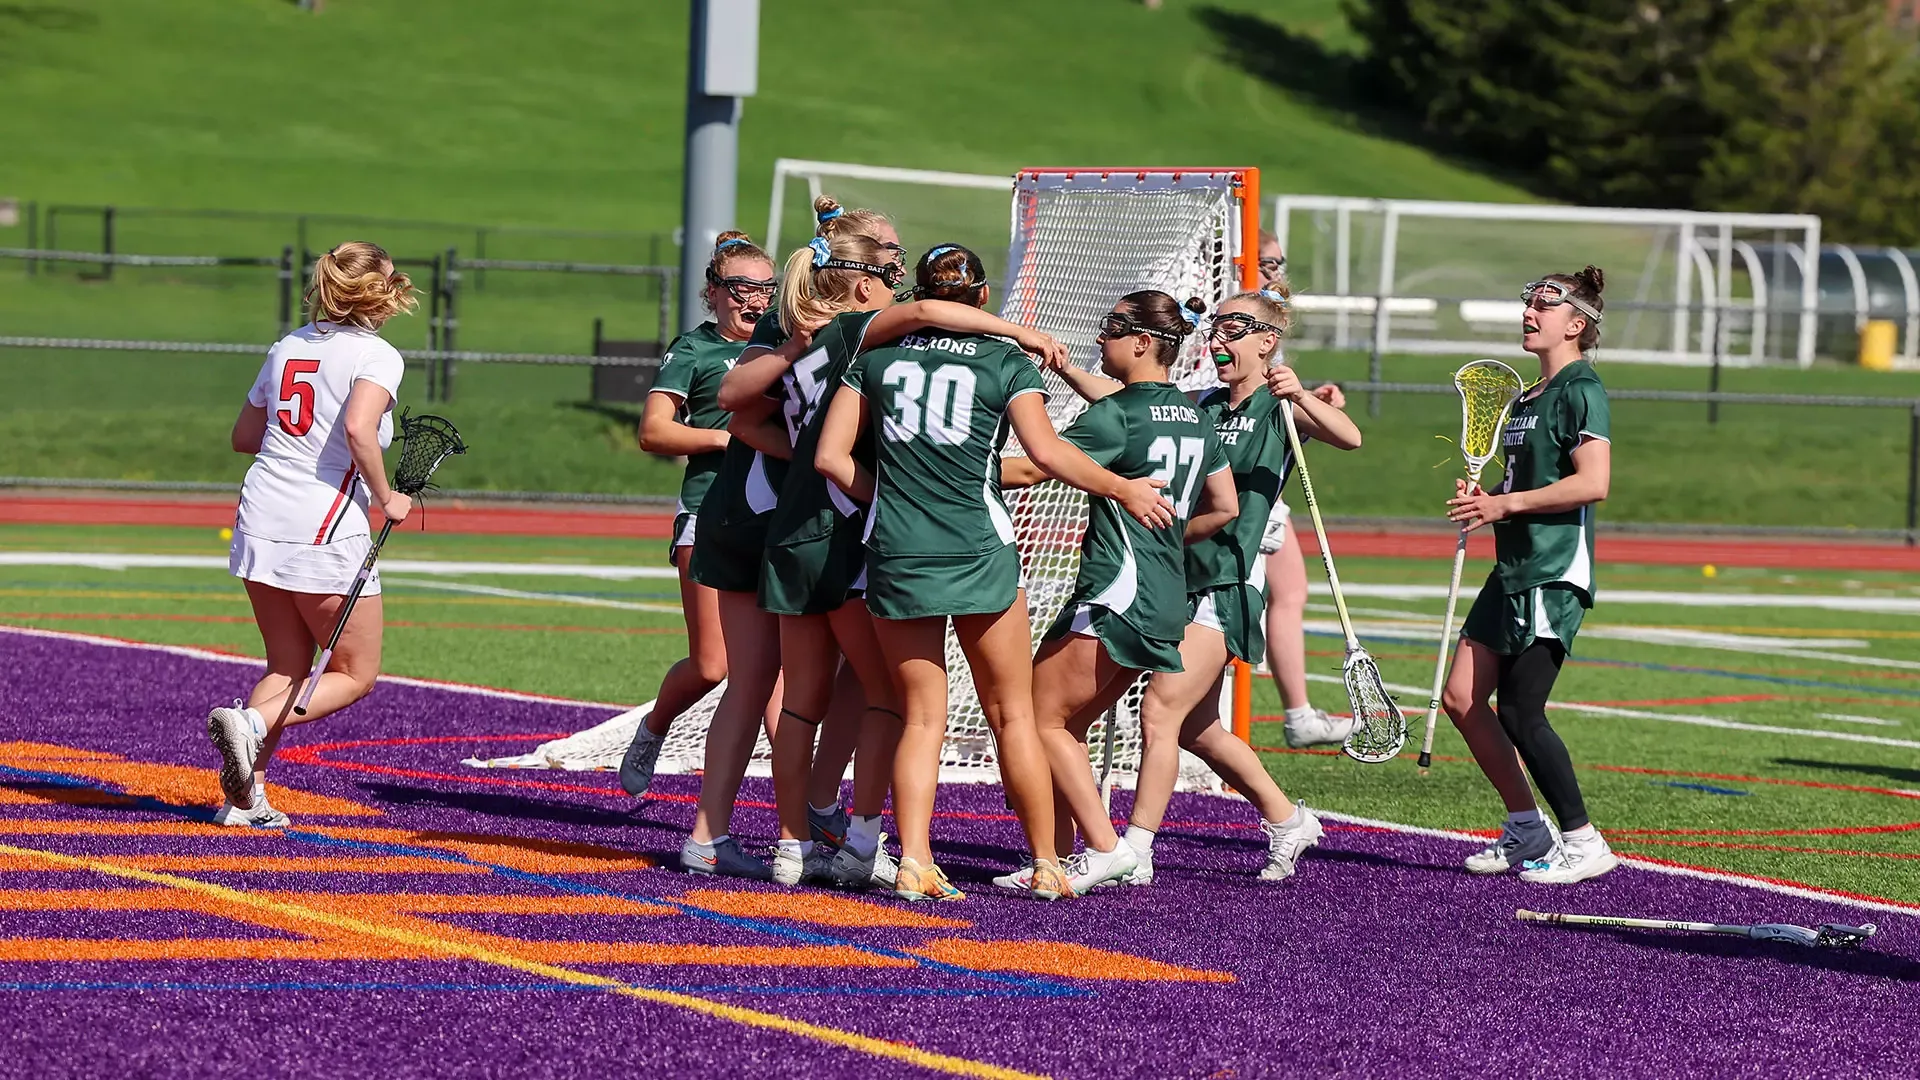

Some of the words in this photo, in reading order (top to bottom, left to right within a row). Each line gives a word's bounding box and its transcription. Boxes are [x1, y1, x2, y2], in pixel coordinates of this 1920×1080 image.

[845, 261, 865, 269] GAIT
[868, 265, 886, 274] GAIT
[1132, 326, 1162, 336] UNDER
[899, 335, 977, 356] HERONS
[277, 359, 320, 436] 5
[882, 360, 977, 447] 30
[1149, 405, 1199, 424] HERONS
[1147, 435, 1205, 521] 27
[1665, 922, 1692, 930] GAIT
